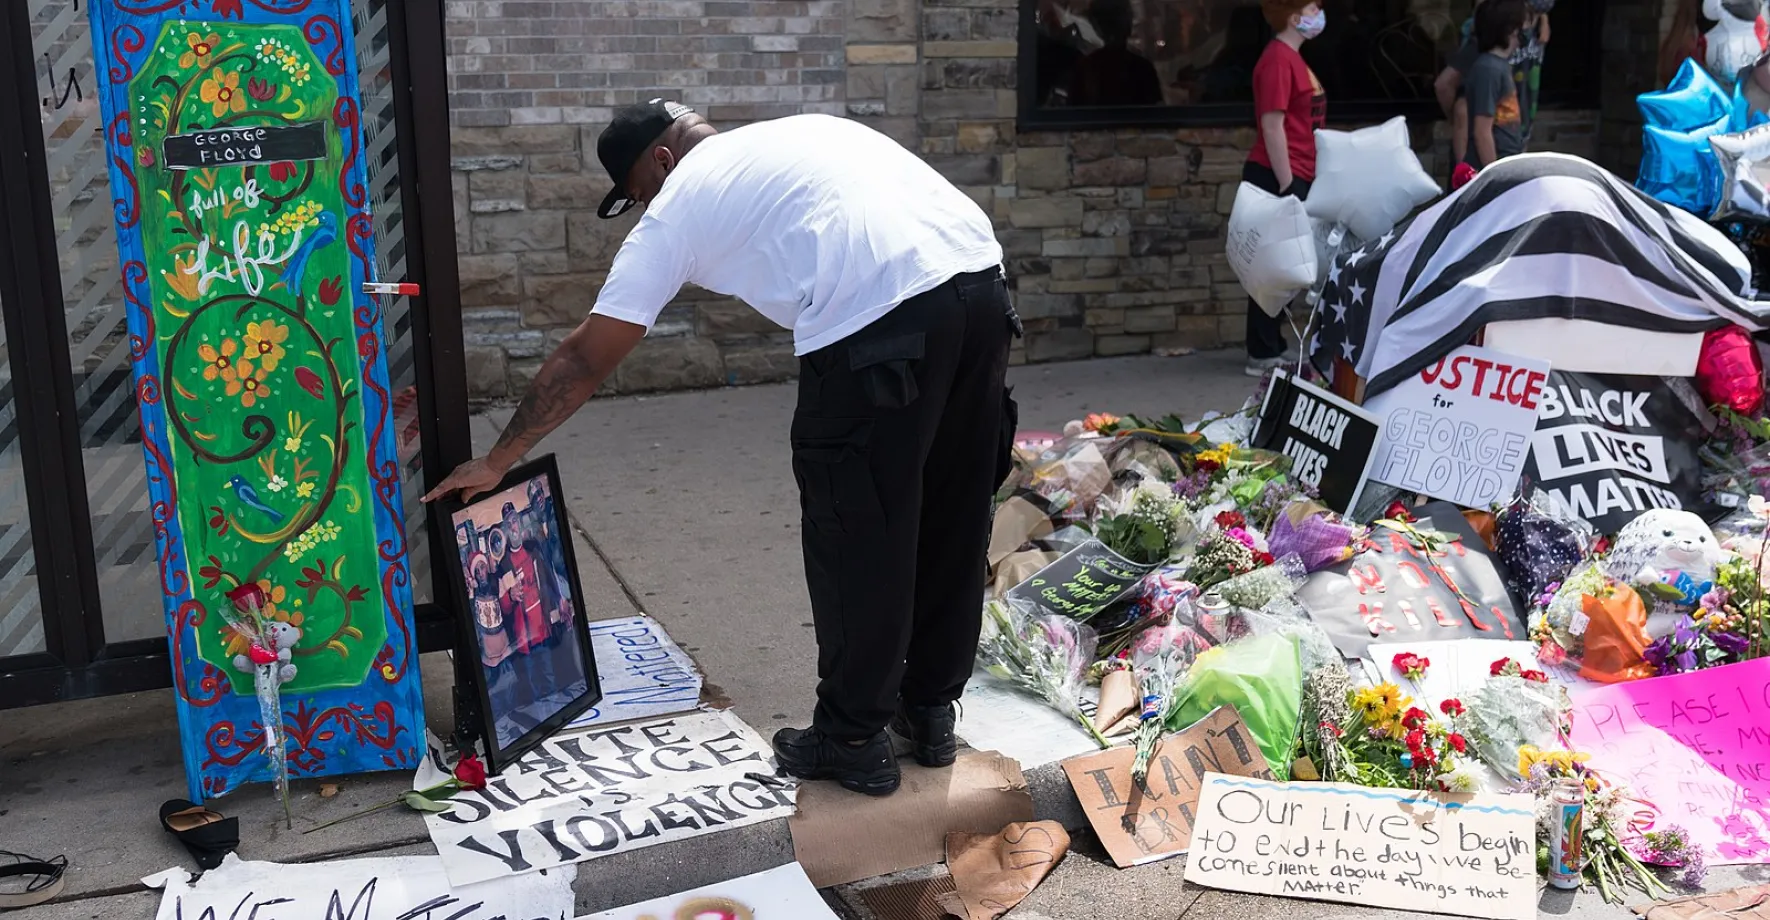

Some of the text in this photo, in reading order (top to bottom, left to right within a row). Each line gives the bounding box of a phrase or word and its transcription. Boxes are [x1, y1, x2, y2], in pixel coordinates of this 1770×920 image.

[189, 179, 264, 219] full of
[1421, 355, 1545, 410] USTICE
[1433, 394, 1454, 408] for
[1289, 393, 1351, 451] BLACK
[1540, 384, 1651, 428] BLACK
[1386, 407, 1526, 472] GEORGE
[1553, 430, 1653, 474] LIVES
[1379, 443, 1502, 508] FLOYD
[1084, 767, 1130, 810] I
[1198, 829, 1236, 853] to
[1459, 822, 1530, 866] begin
[1331, 862, 1387, 881] about
[1465, 885, 1509, 899] that
